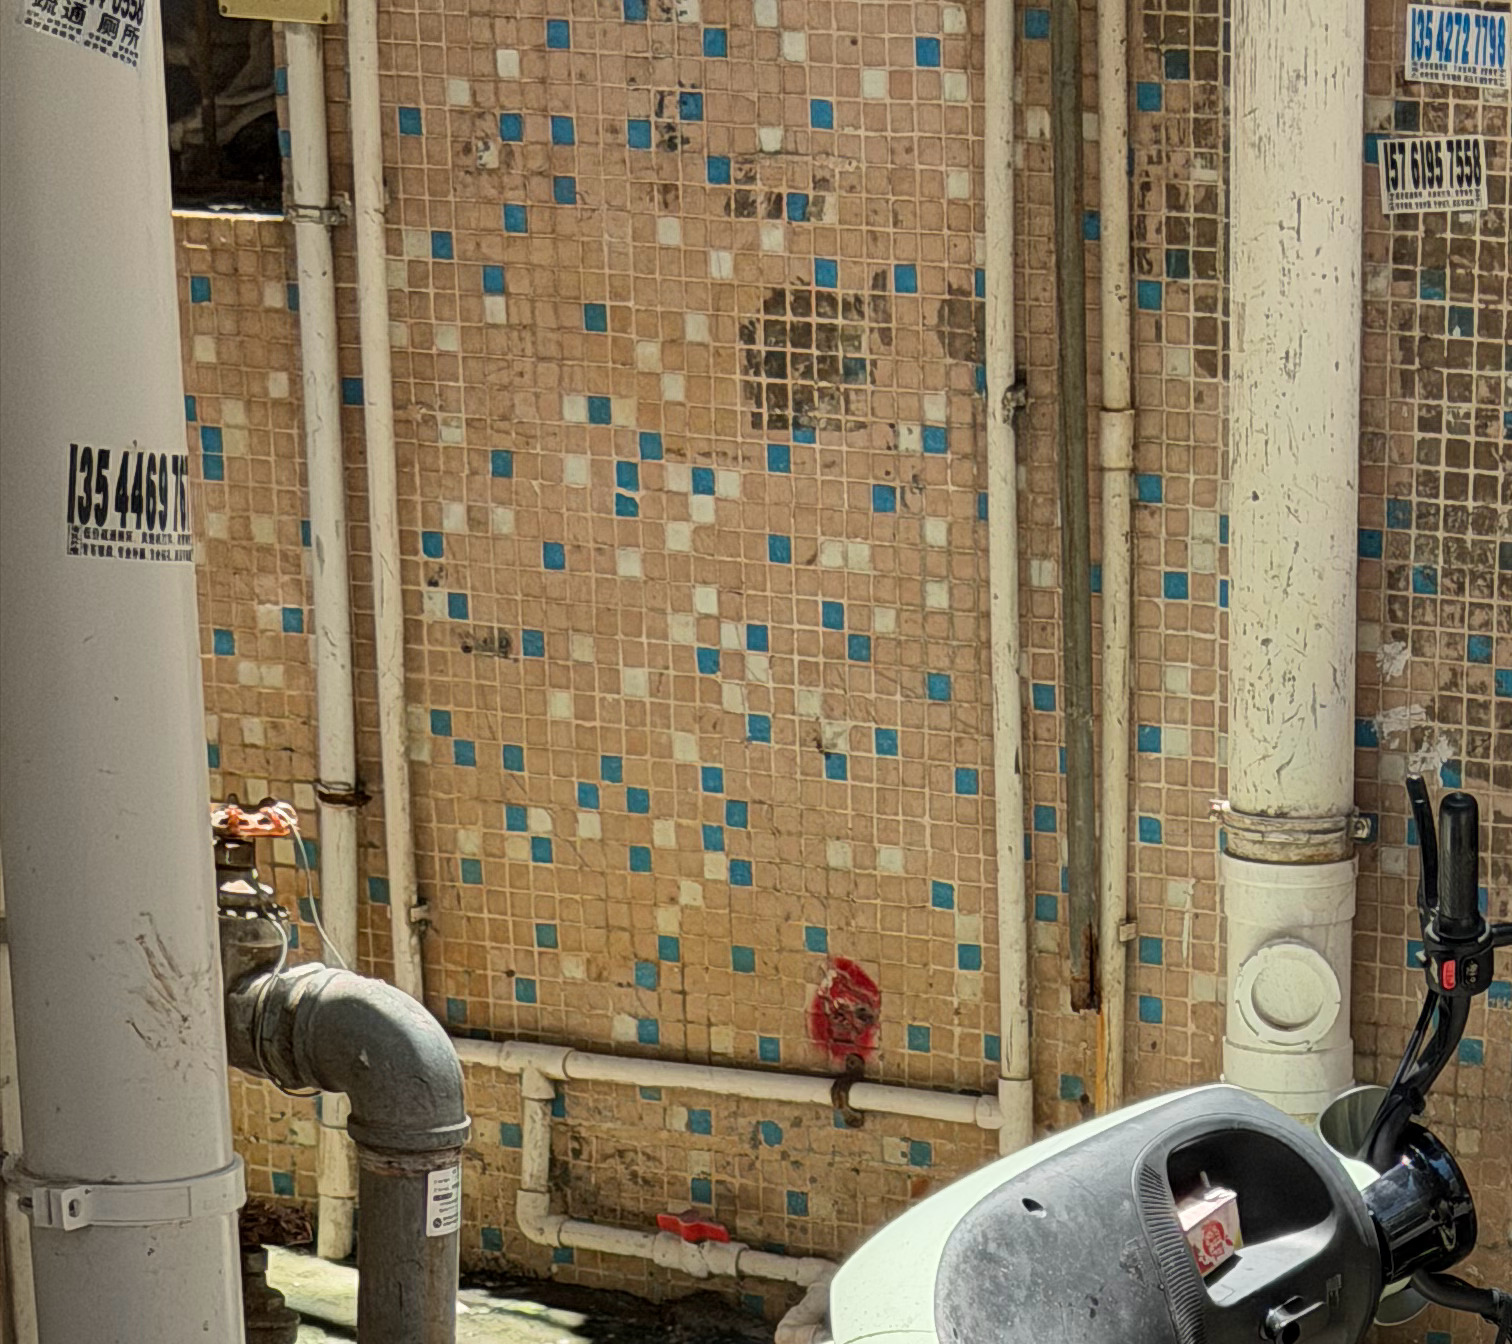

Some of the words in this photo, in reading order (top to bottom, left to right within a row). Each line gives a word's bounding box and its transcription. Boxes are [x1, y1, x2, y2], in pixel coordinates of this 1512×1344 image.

[1411, 8, 1433, 61] 135
[1436, 11, 1470, 65] 4272
[1474, 14, 1506, 68] 7798
[1383, 141, 1406, 192] 157
[1411, 140, 1443, 190] 6195
[1446, 138, 1481, 188] 7558
[67, 443, 110, 527] 135
[114, 450, 169, 532] 4469
